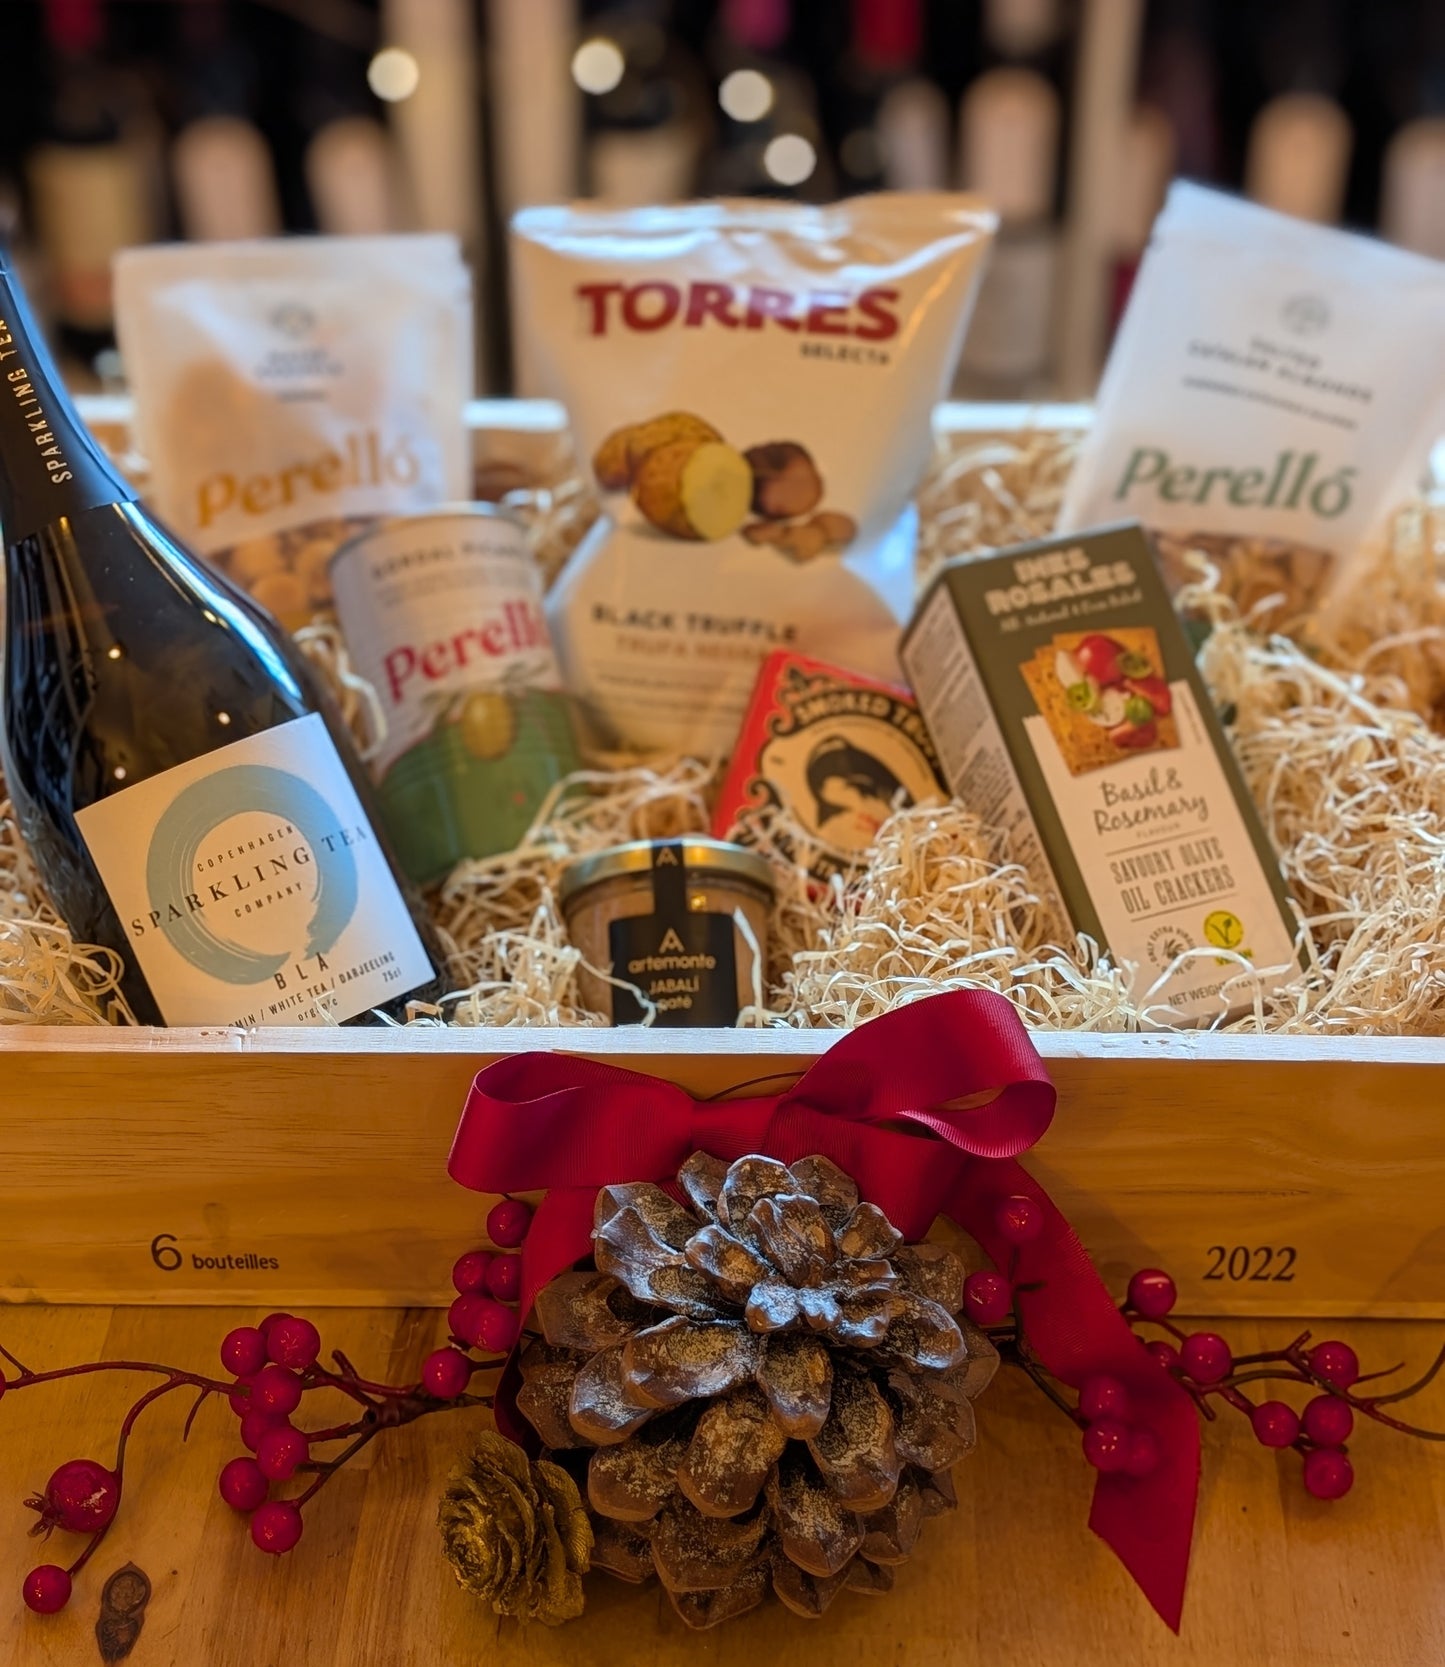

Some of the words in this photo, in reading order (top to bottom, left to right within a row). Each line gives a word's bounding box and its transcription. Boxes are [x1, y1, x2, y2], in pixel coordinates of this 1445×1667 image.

[578, 280, 901, 342] TORRES
[799, 341, 891, 366] SELECTA
[7, 368, 73, 483] SPARKLING
[1114, 446, 1358, 519] Perelló
[984, 560, 1137, 615] ROSALES
[592, 603, 673, 631] BLACK
[687, 611, 798, 645] TRUFFLE
[1093, 796, 1209, 835] Rosemary
[197, 825, 294, 872] COPENHAGEN
[1110, 848, 1175, 885] SAVOURY
[1178, 836, 1225, 867] OLIVE
[131, 846, 311, 936] SPARKLING
[321, 826, 367, 853] TEA
[235, 882, 303, 918] COMPANY
[1121, 886, 1151, 914] OIL
[1153, 864, 1236, 906] CRACKERS
[268, 994, 304, 1015] WHITE
[307, 983, 327, 997] TEA
[339, 951, 395, 984] DARJEELING
[382, 967, 401, 983] 75cl
[628, 954, 716, 974] artemonte
[649, 976, 699, 995] JABALÍ
[1168, 993, 1187, 1007] NET
[297, 997, 338, 1022] orgnic
[151, 1233, 182, 1271] 6
[191, 1254, 279, 1270] bouteilles
[1202, 1246, 1297, 1281] 2022
